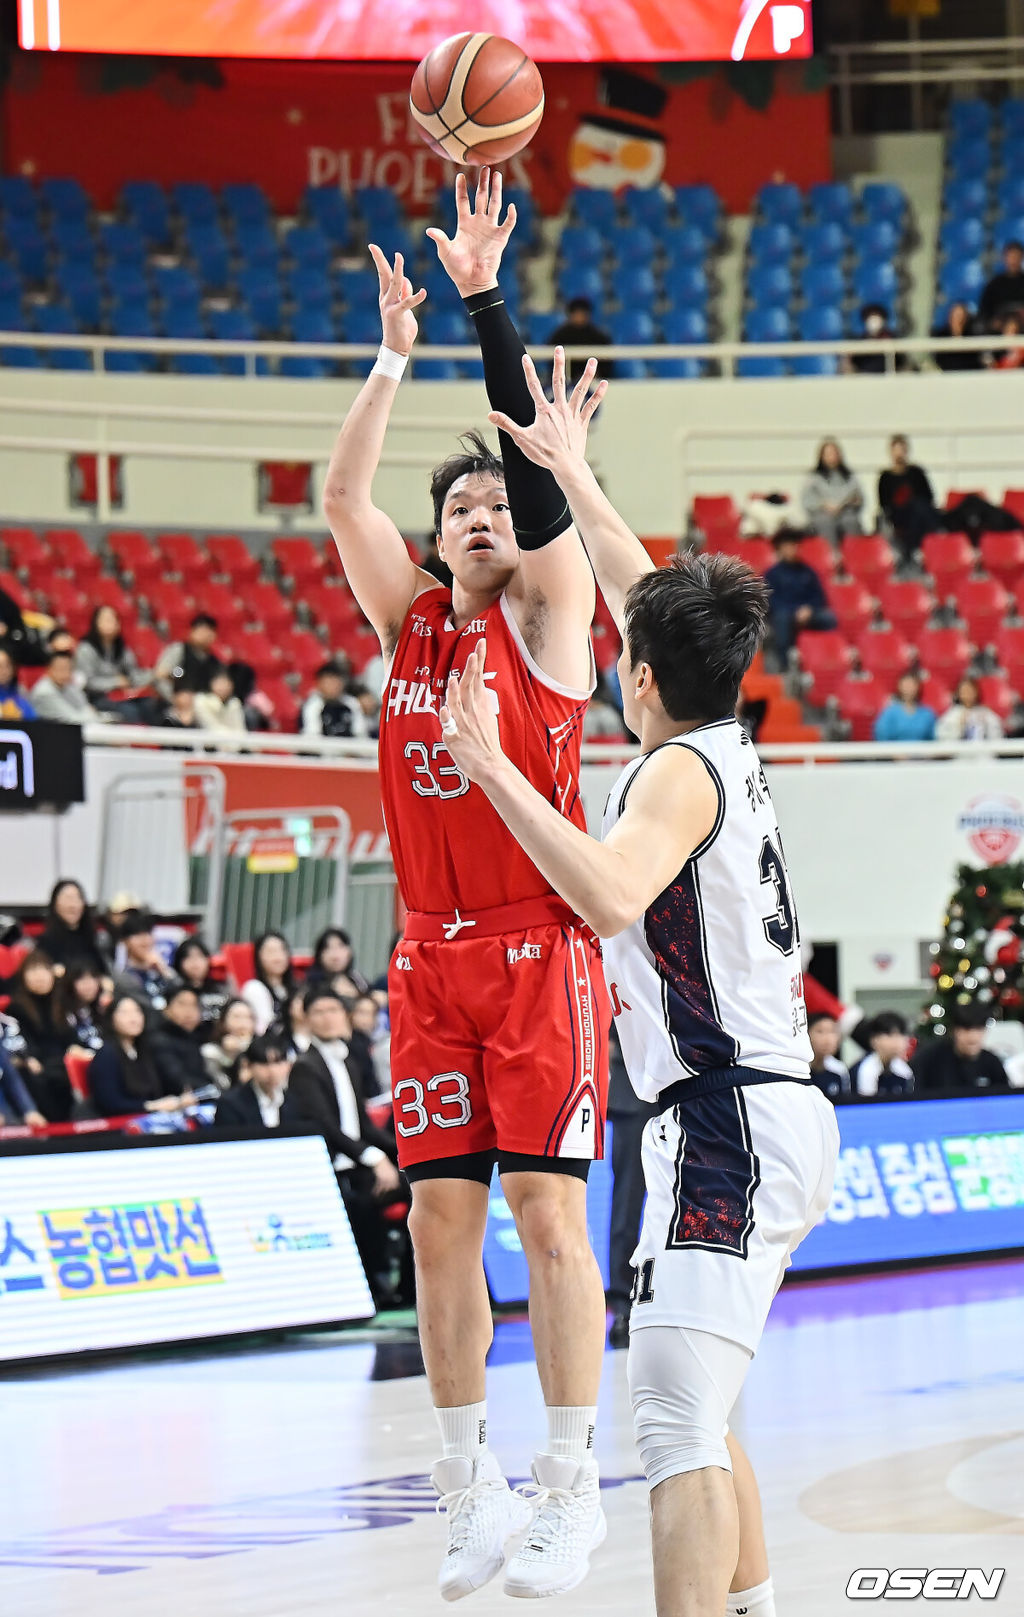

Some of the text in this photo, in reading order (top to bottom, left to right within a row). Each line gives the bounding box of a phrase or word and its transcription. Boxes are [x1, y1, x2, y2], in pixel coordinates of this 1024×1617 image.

[404, 741, 471, 800] 33
[759, 826, 802, 957] 3
[581, 994, 592, 1070] HYUNDAI MOBIS
[394, 1070, 473, 1138] 33
[581, 1108, 590, 1133] P
[876, 1139, 957, 1218] 중심
[45, 1203, 222, 1291] 농협맛선
